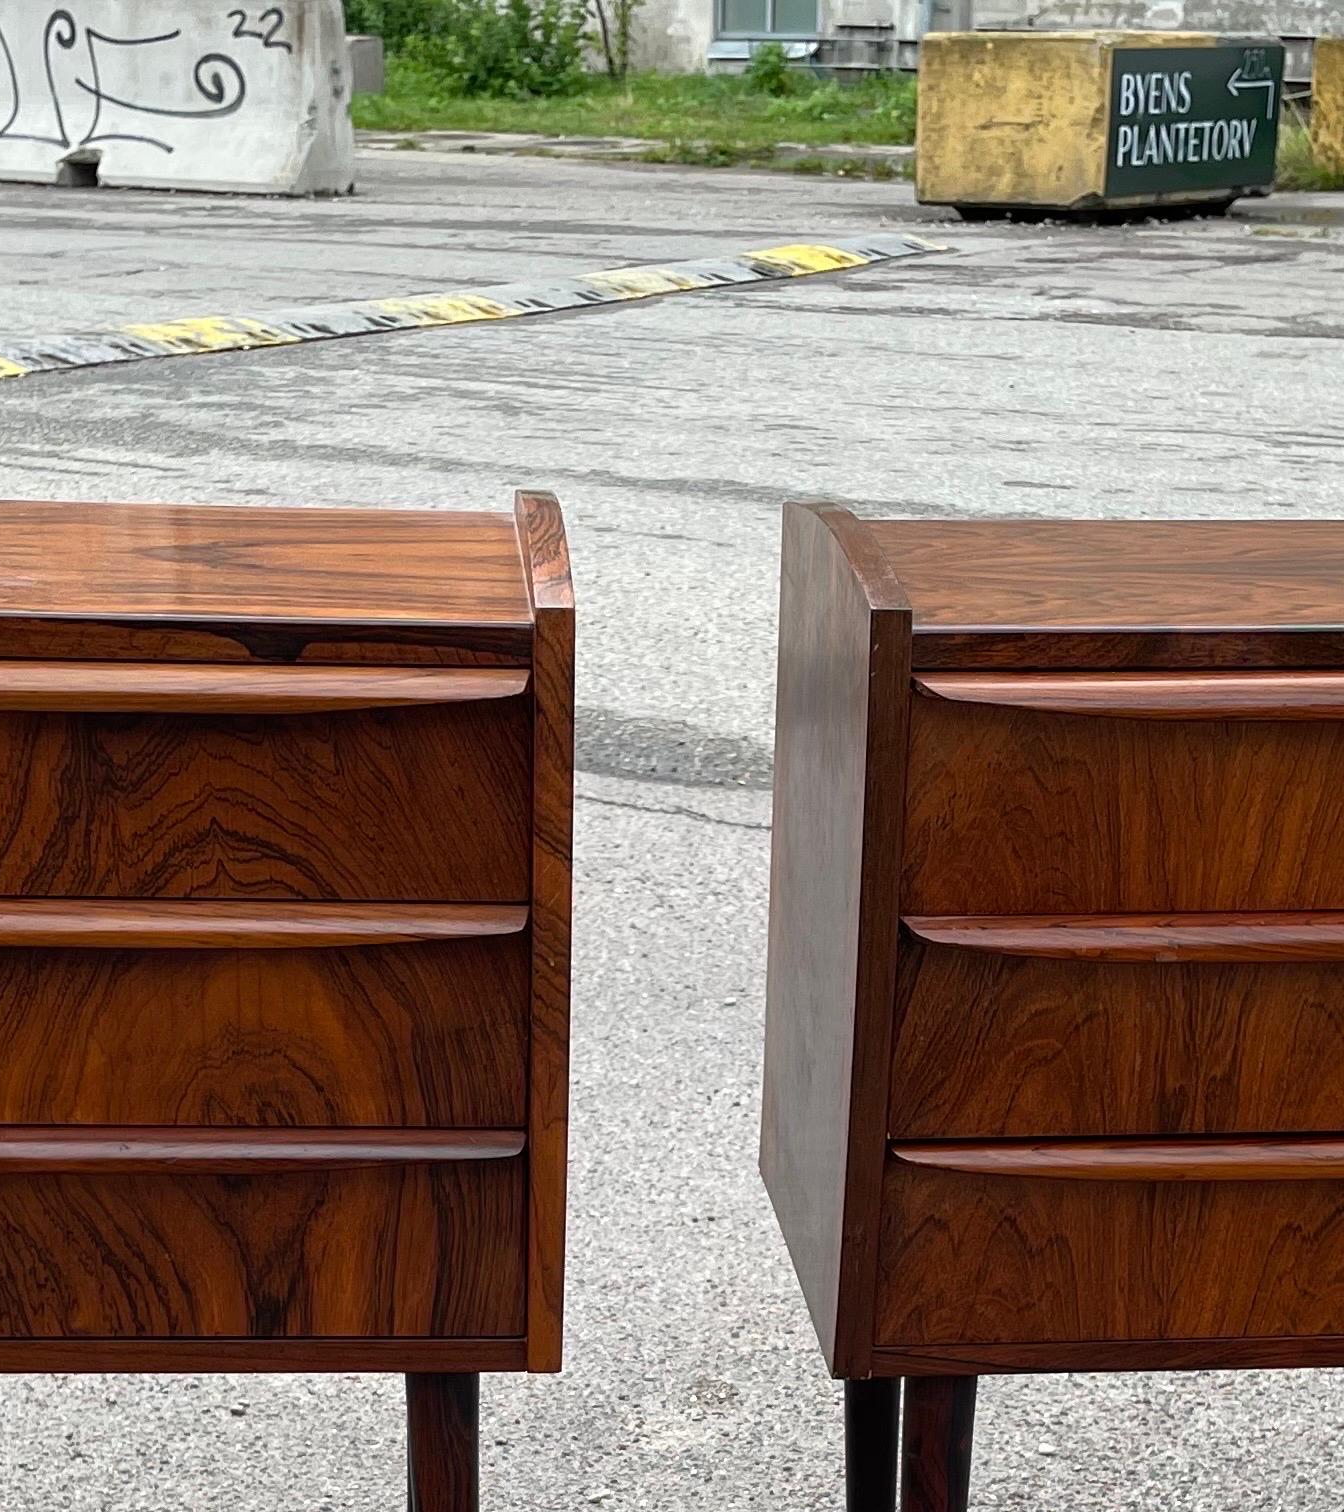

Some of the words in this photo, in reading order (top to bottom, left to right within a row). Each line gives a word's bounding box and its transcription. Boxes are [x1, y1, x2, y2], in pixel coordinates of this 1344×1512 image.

[226, 9, 292, 54] 22
[1119, 71, 1192, 116] BYENS
[1116, 117, 1257, 168] PLANTETORV
